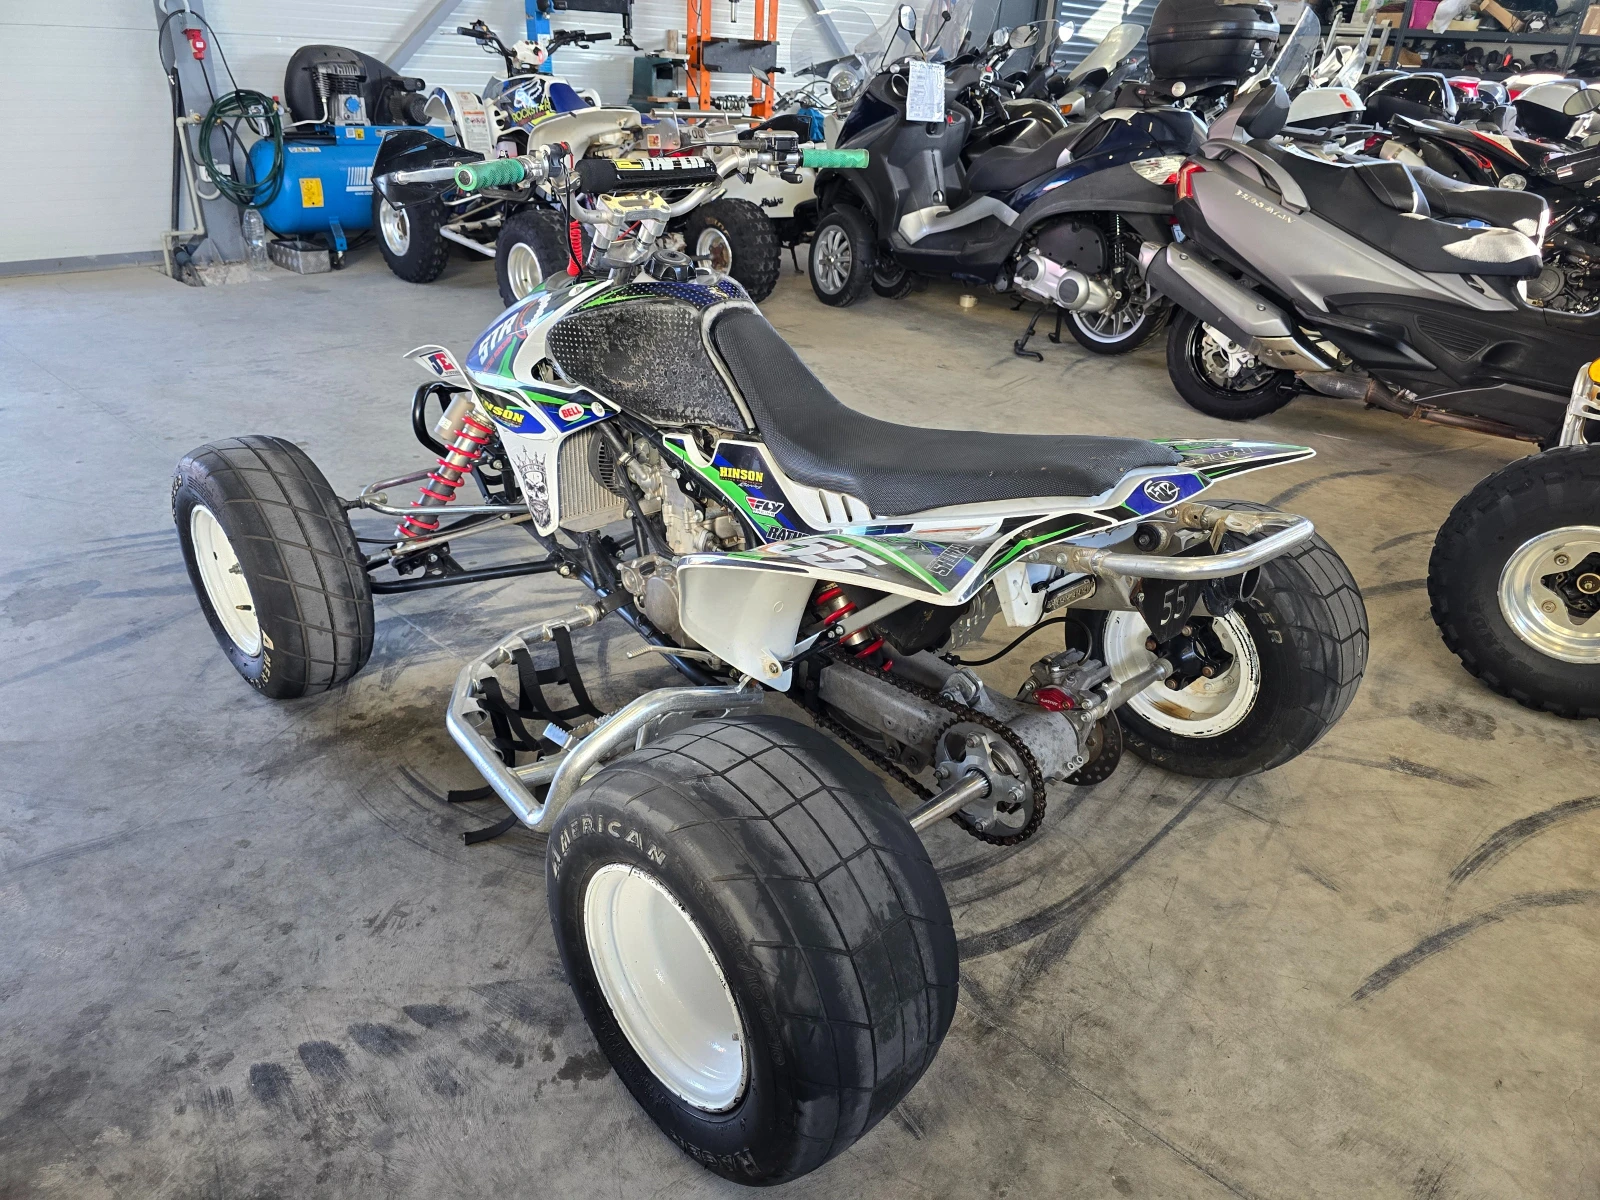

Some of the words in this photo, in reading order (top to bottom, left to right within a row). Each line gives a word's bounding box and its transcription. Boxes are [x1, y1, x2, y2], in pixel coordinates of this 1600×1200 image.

[478, 312, 519, 365] STR
[428, 351, 455, 376] JE
[561, 407, 582, 418] BELL
[719, 467, 764, 482] HINSON
[754, 500, 784, 512] FLY
[1160, 583, 1188, 625] 55
[551, 813, 668, 882] AMERICAN
